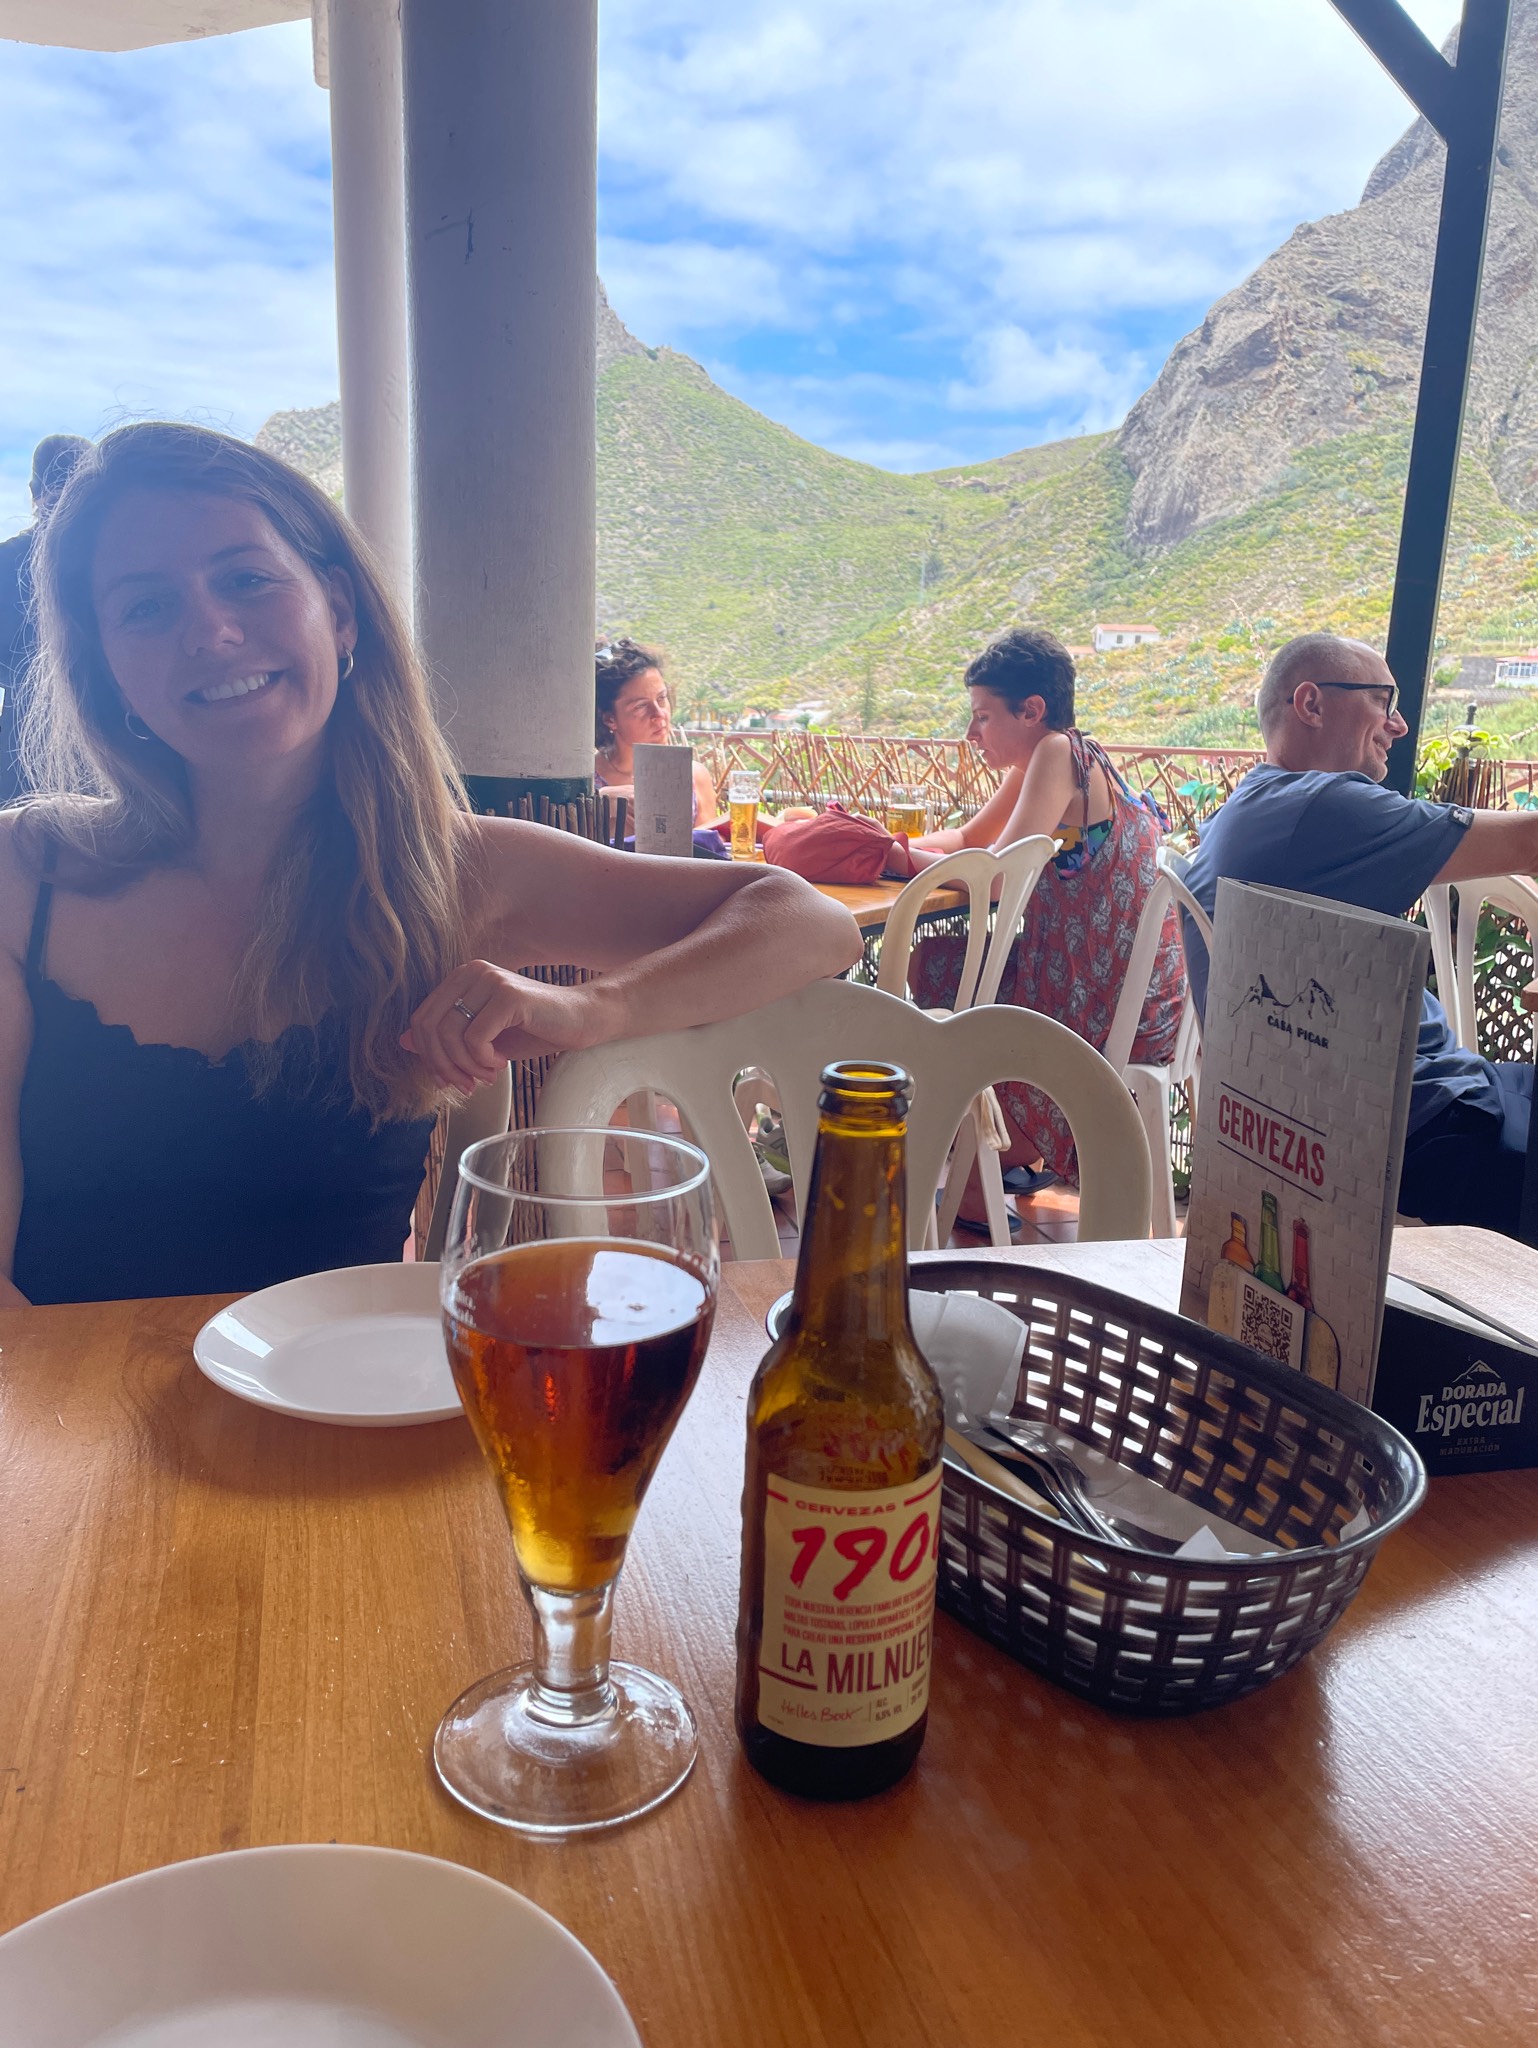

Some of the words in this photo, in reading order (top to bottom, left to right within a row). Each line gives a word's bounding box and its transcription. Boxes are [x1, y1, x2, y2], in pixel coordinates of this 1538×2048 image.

[1267, 1015, 1292, 1034] CASA
[1297, 1027, 1329, 1049] PICAR
[1219, 1094, 1325, 1186] CERVEZAS
[1442, 1382, 1507, 1401] DORADA
[1415, 1387, 1525, 1436] Especial
[1456, 1436, 1486, 1446] EXTRA
[795, 1500, 896, 1517] CERVEZAS
[784, 1609, 809, 1626] MALTAS
[803, 1600, 835, 1615] NUESTRA
[836, 1604, 872, 1616] HERENCIA
[802, 1630, 827, 1644] CREAR
[828, 1634, 844, 1645] UNA
[845, 1632, 882, 1646] RESERVA
[884, 1620, 914, 1639] ESPECIAL
[781, 1642, 815, 1677] LA
[780, 1699, 818, 1721] Helles
[820, 1706, 863, 1723] Bock
